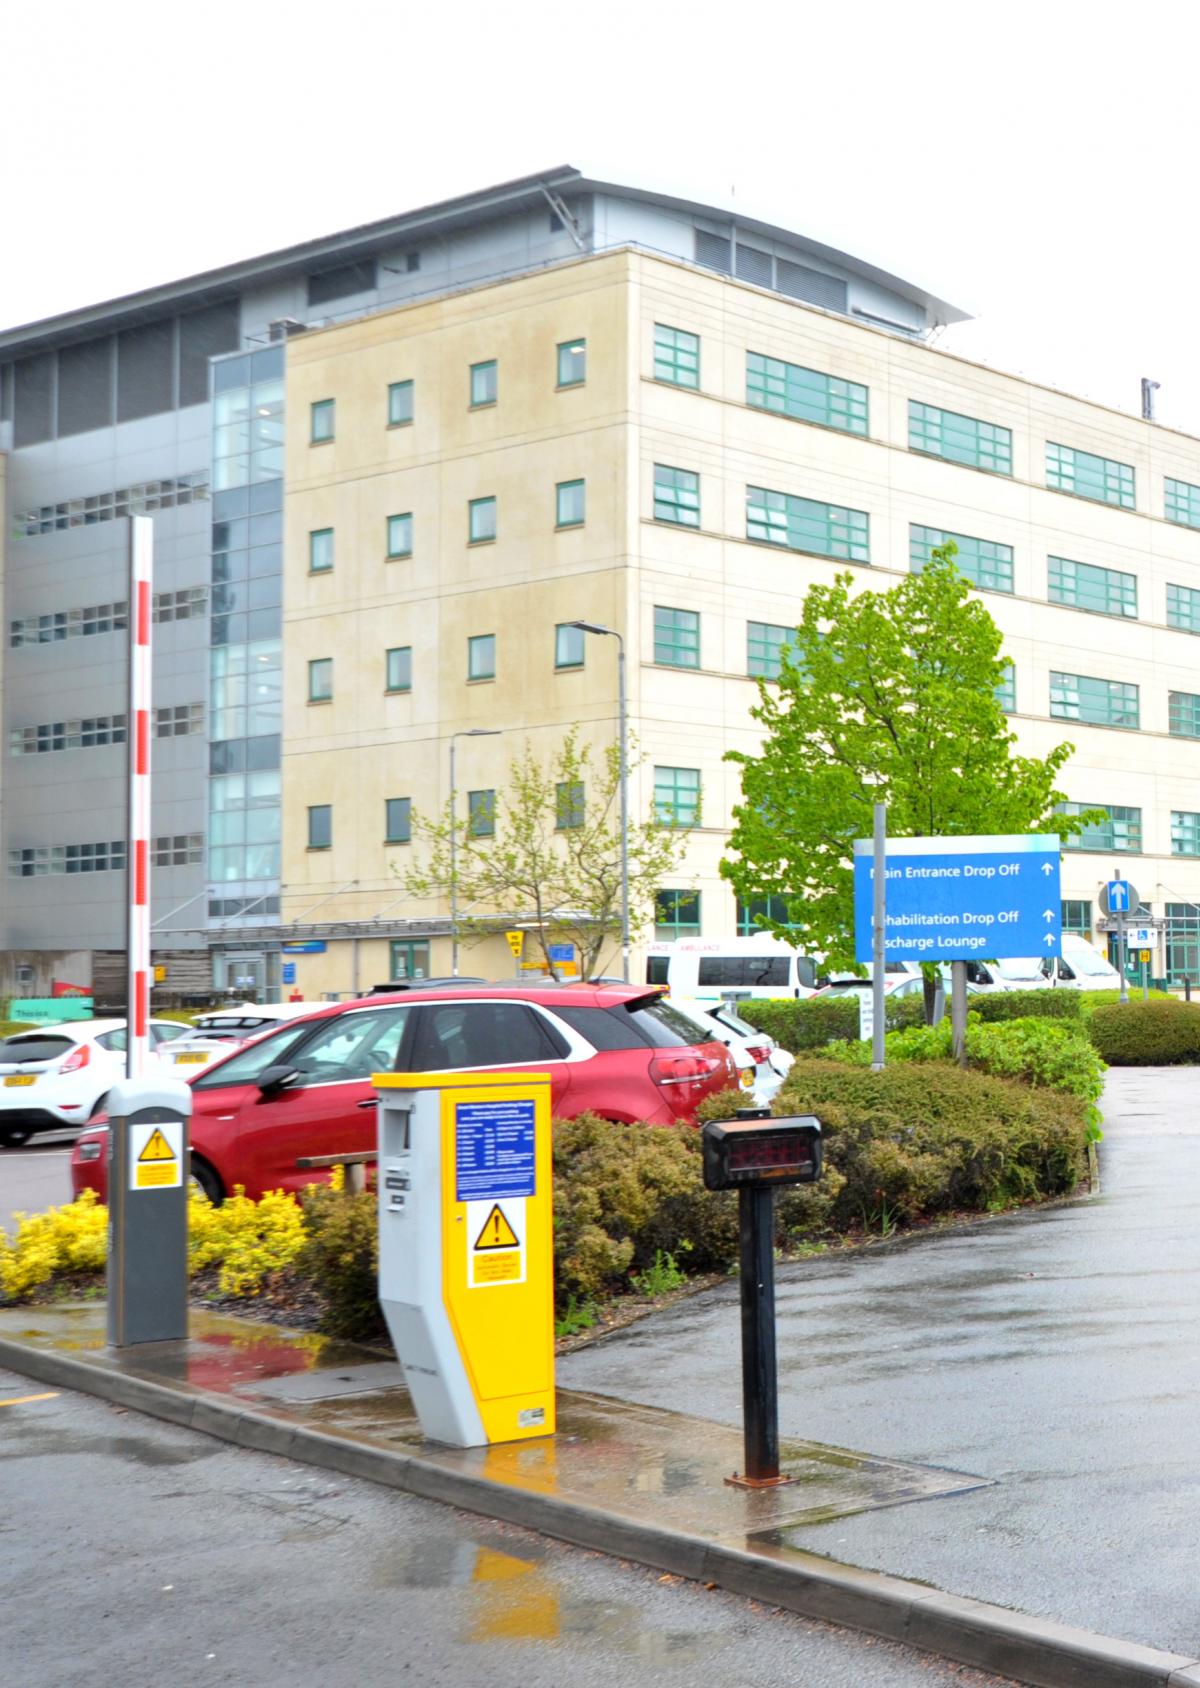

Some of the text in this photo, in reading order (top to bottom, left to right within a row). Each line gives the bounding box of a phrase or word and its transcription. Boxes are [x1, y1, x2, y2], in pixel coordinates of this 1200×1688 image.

[905, 866, 960, 878] Entrance
[964, 865, 995, 879] Drop
[998, 863, 1020, 876] Off
[871, 910, 1019, 926] habilitation Drop Off
[872, 935, 986, 950] scharge Lounge
